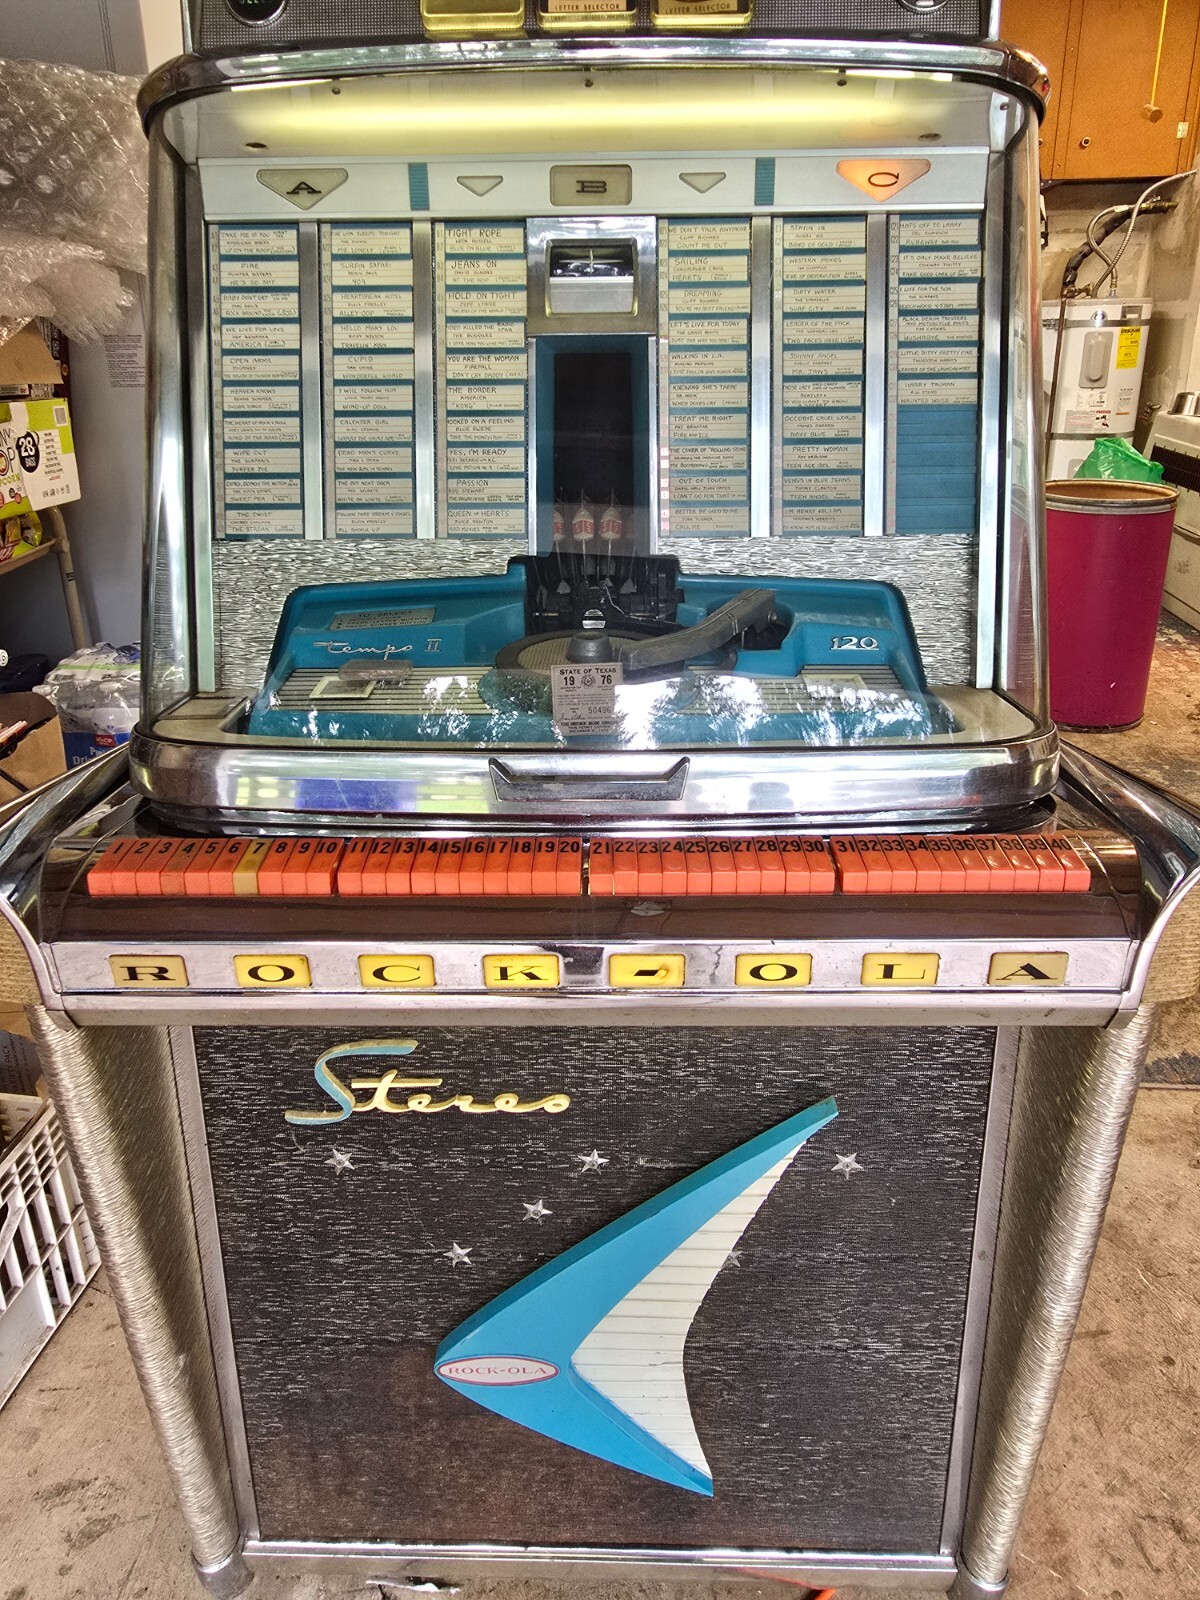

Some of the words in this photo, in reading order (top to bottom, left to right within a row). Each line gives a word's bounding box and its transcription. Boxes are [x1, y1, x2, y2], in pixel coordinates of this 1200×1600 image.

[868, 171, 900, 188] C
[286, 181, 321, 194] A
[576, 179, 607, 193] B
[448, 229, 474, 237] TIGHT
[451, 260, 480, 268] JEANS
[19, 437, 36, 457] 28
[313, 641, 413, 660] tempo
[564, 676, 575, 686] 19
[600, 675, 612, 684] 76
[112, 842, 124, 853] 1
[134, 842, 150, 853] 2
[159, 842, 173, 853] 3
[182, 842, 196, 853] 4
[205, 842, 220, 853] 5
[228, 842, 242, 853] 6
[253, 842, 265, 853] 7
[276, 842, 288, 853] 8
[298, 842, 310, 853] 9
[318, 842, 336, 853] 10
[352, 842, 367, 853] 11
[373, 842, 390, 853] 12
[396, 842, 414, 853] 13
[420, 842, 439, 853] 14
[443, 842, 461, 853] 15
[467, 842, 484, 853] 16
[490, 842, 508, 853] 17
[514, 842, 531, 853] 18
[538, 842, 554, 853] 19
[560, 842, 579, 853] 20
[593, 841, 609, 853] 21
[615, 841, 634, 853] 22
[638, 841, 658, 853] 23
[662, 841, 683, 853] 24
[686, 841, 706, 853] 25
[709, 841, 729, 853] 26
[733, 841, 750, 853] 27
[757, 841, 777, 853] 28
[780, 841, 800, 853] 29
[803, 841, 823, 853] 30
[836, 840, 855, 852] 31
[858, 840, 878, 852] 32
[881, 840, 901, 852] 33
[905, 840, 926, 852] 34
[929, 840, 949, 852] 35
[953, 840, 973, 852] 36
[977, 840, 997, 852] 37
[1001, 840, 1021, 852] 38
[1025, 840, 1046, 852] 39
[1052, 840, 1071, 852] 40
[285, 1039, 570, 1125] Stereo
[448, 1367, 547, 1375] ROCK-OLA
